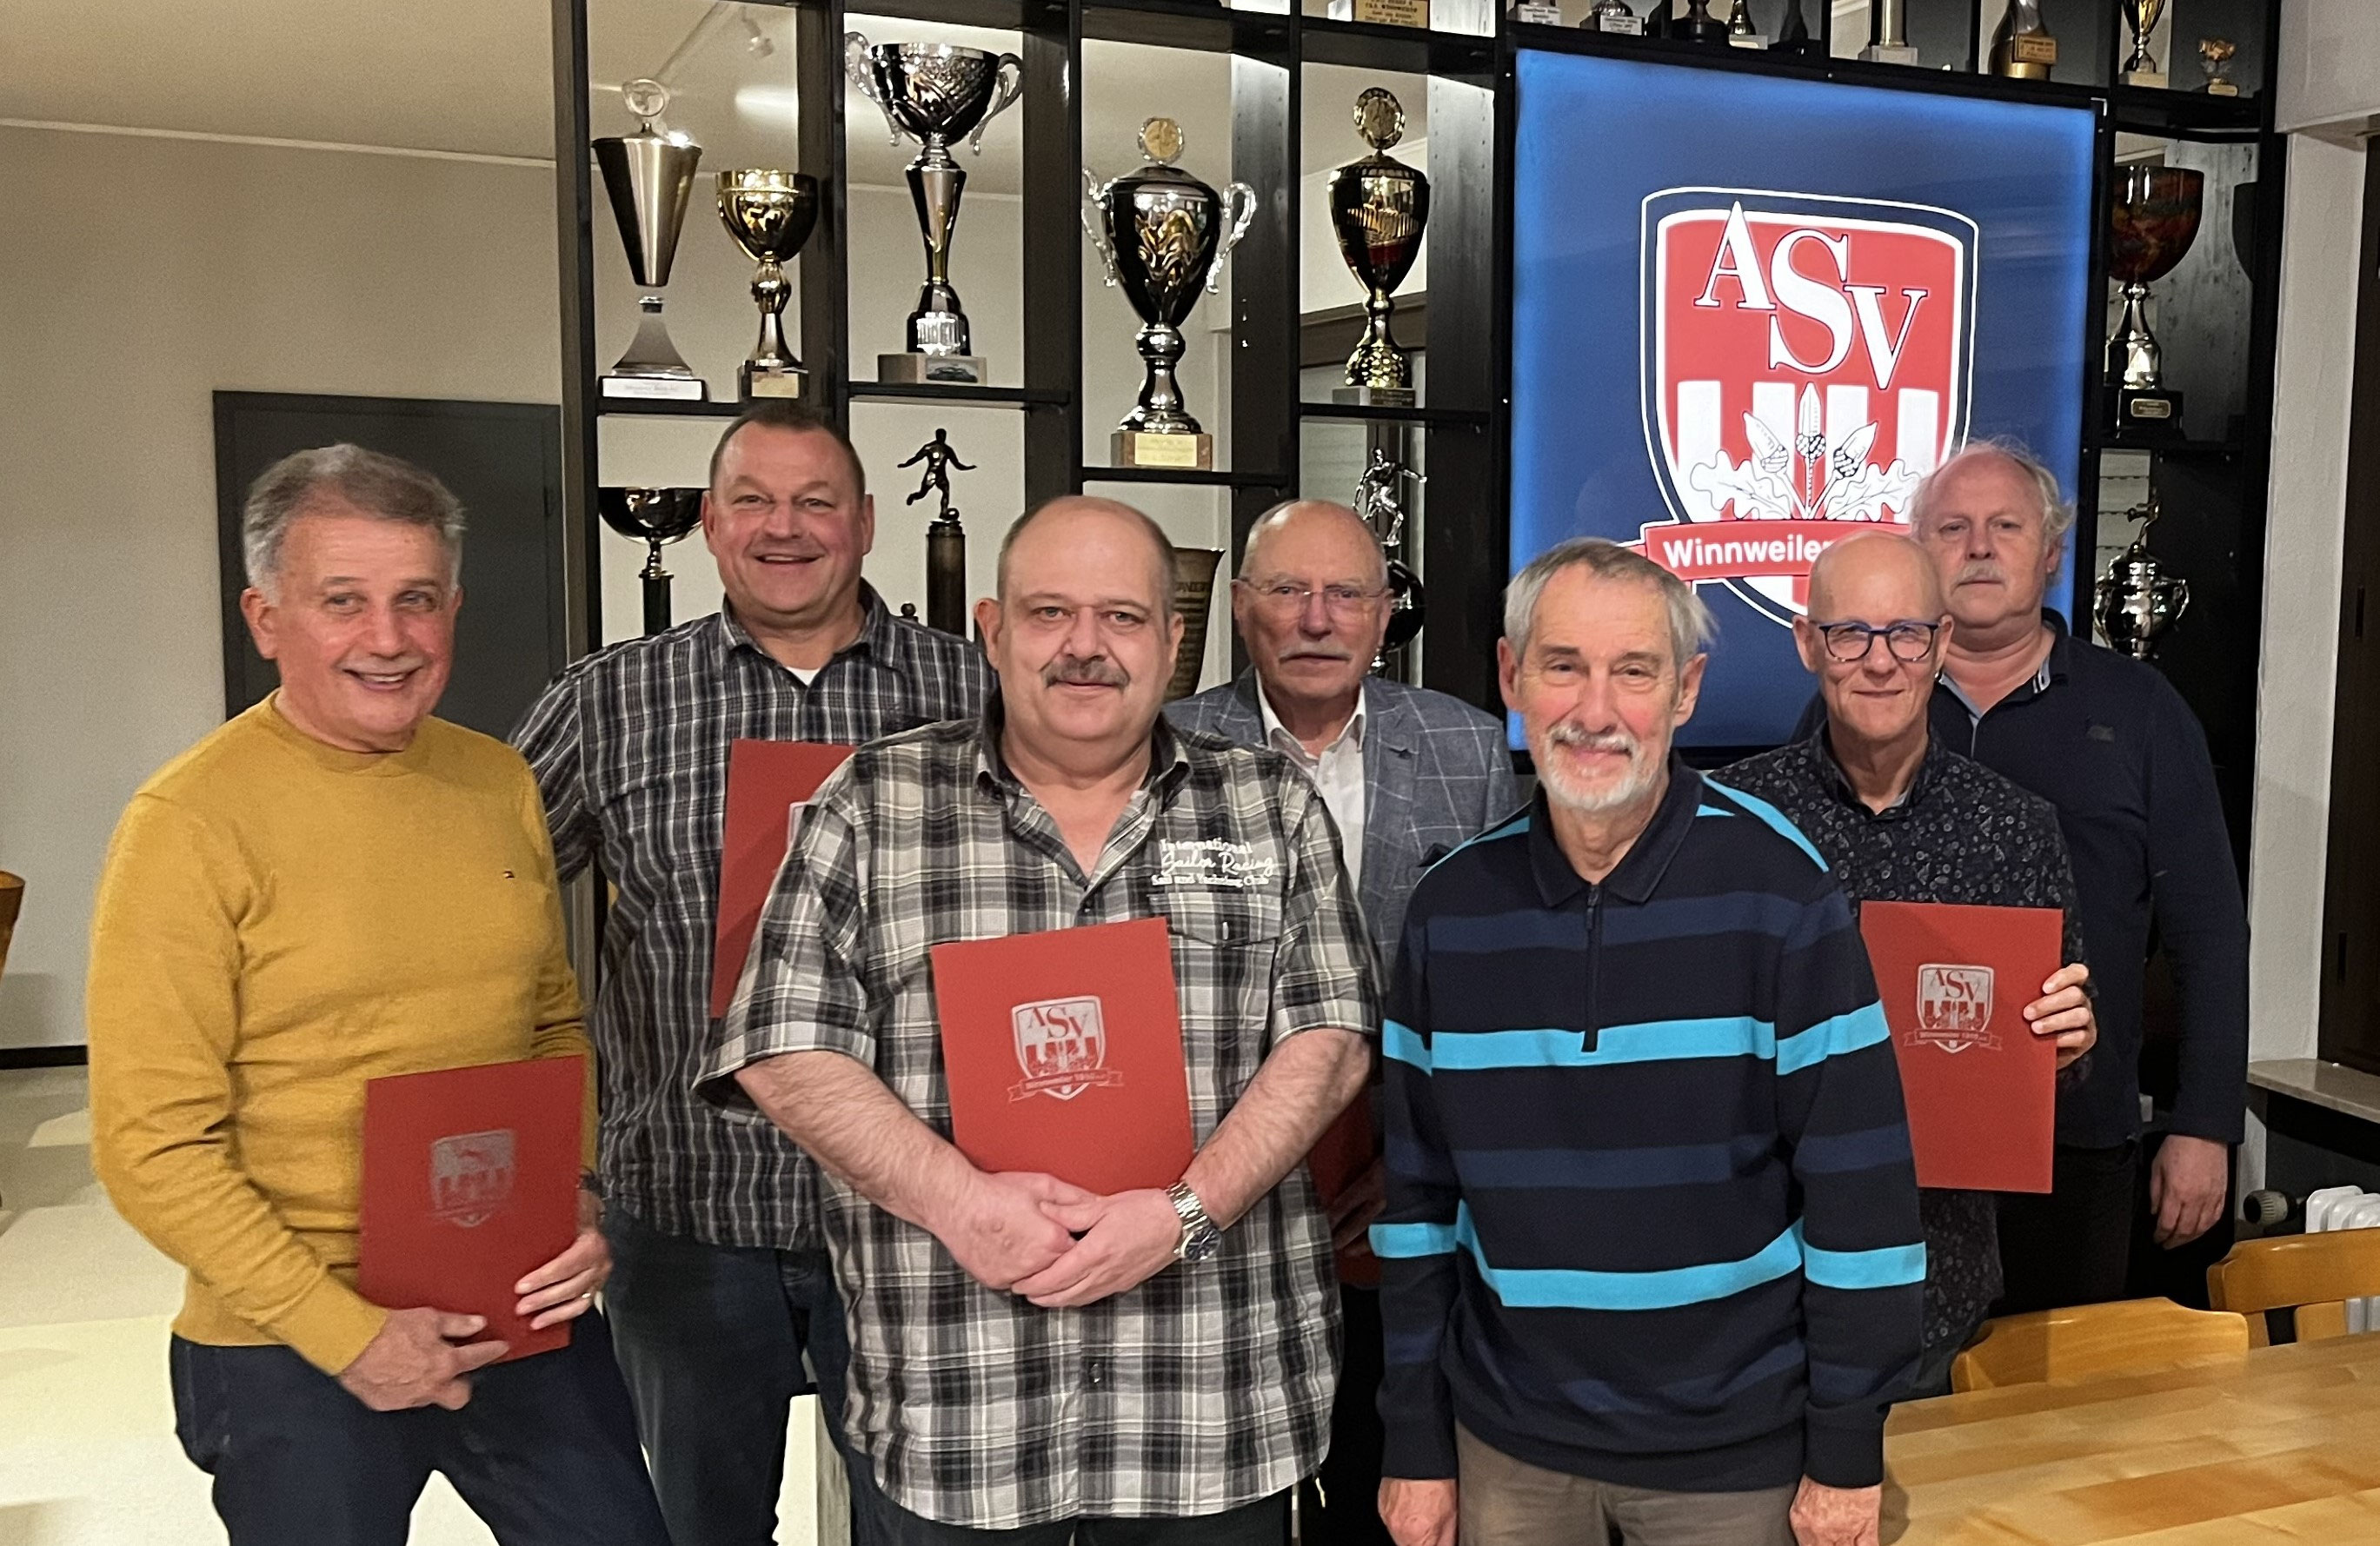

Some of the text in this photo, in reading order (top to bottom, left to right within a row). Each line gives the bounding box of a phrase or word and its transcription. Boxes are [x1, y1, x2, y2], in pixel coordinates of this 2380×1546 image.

[1693, 200, 1928, 390] ASV
[1929, 968, 1981, 1001] ASV
[1027, 1005, 1088, 1038] ASV
